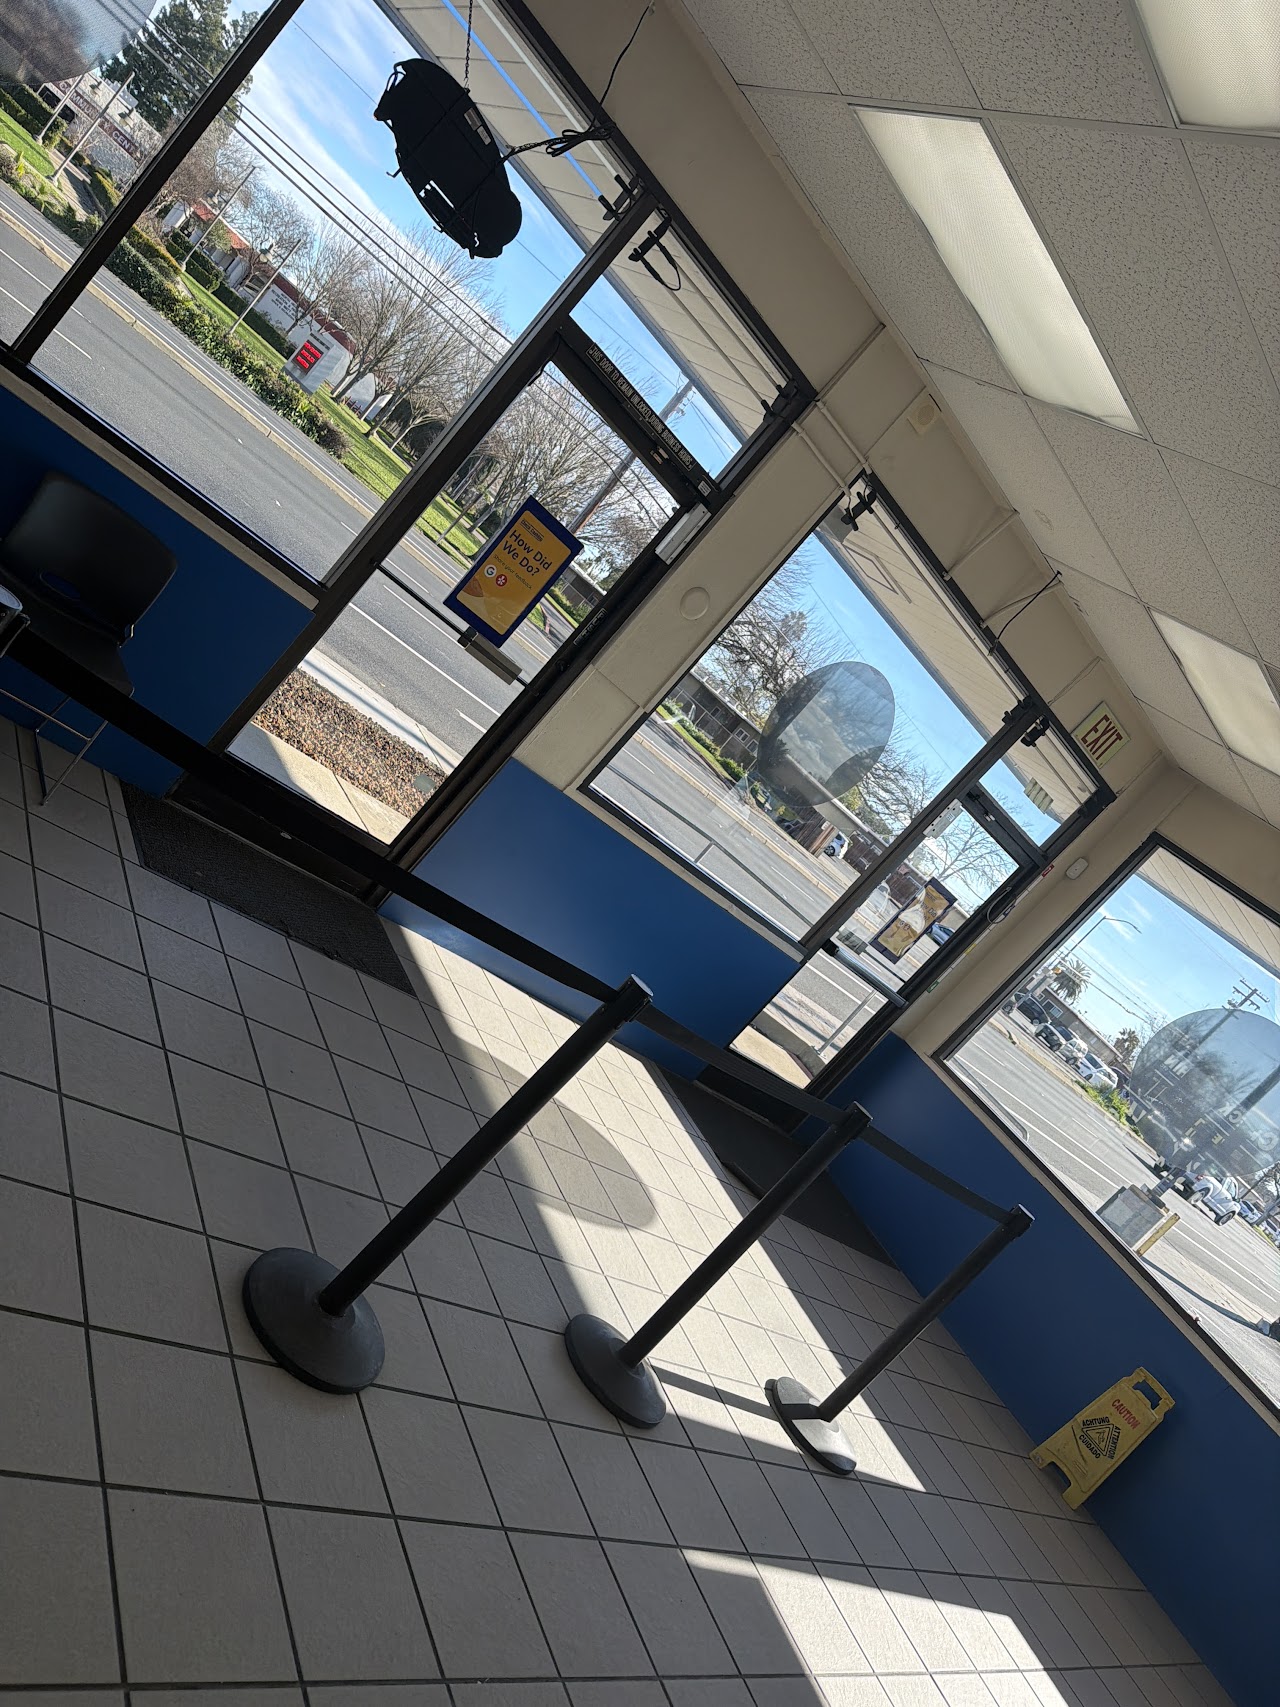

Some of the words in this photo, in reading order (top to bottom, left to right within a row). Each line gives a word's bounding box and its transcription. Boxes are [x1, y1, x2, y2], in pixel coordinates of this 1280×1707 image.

[589, 346, 603, 361] THIS
[600, 357, 614, 375] DOOR
[611, 369, 620, 380] TO
[616, 376, 635, 398] REMAIN
[661, 429, 682, 453] BUSINESS
[678, 448, 693, 466] HOURS
[502, 540, 520, 561] We
[518, 556, 541, 577] Do?
[509, 529, 534, 555] How
[532, 550, 553, 571] Did
[1080, 713, 1124, 761] EXIT
[1081, 1416, 1111, 1427] ACHTUNG
[1111, 1398, 1141, 1430] CAUTION
[1078, 1434, 1101, 1459] CUIDADO
[1107, 1425, 1122, 1460] ATTENTION
